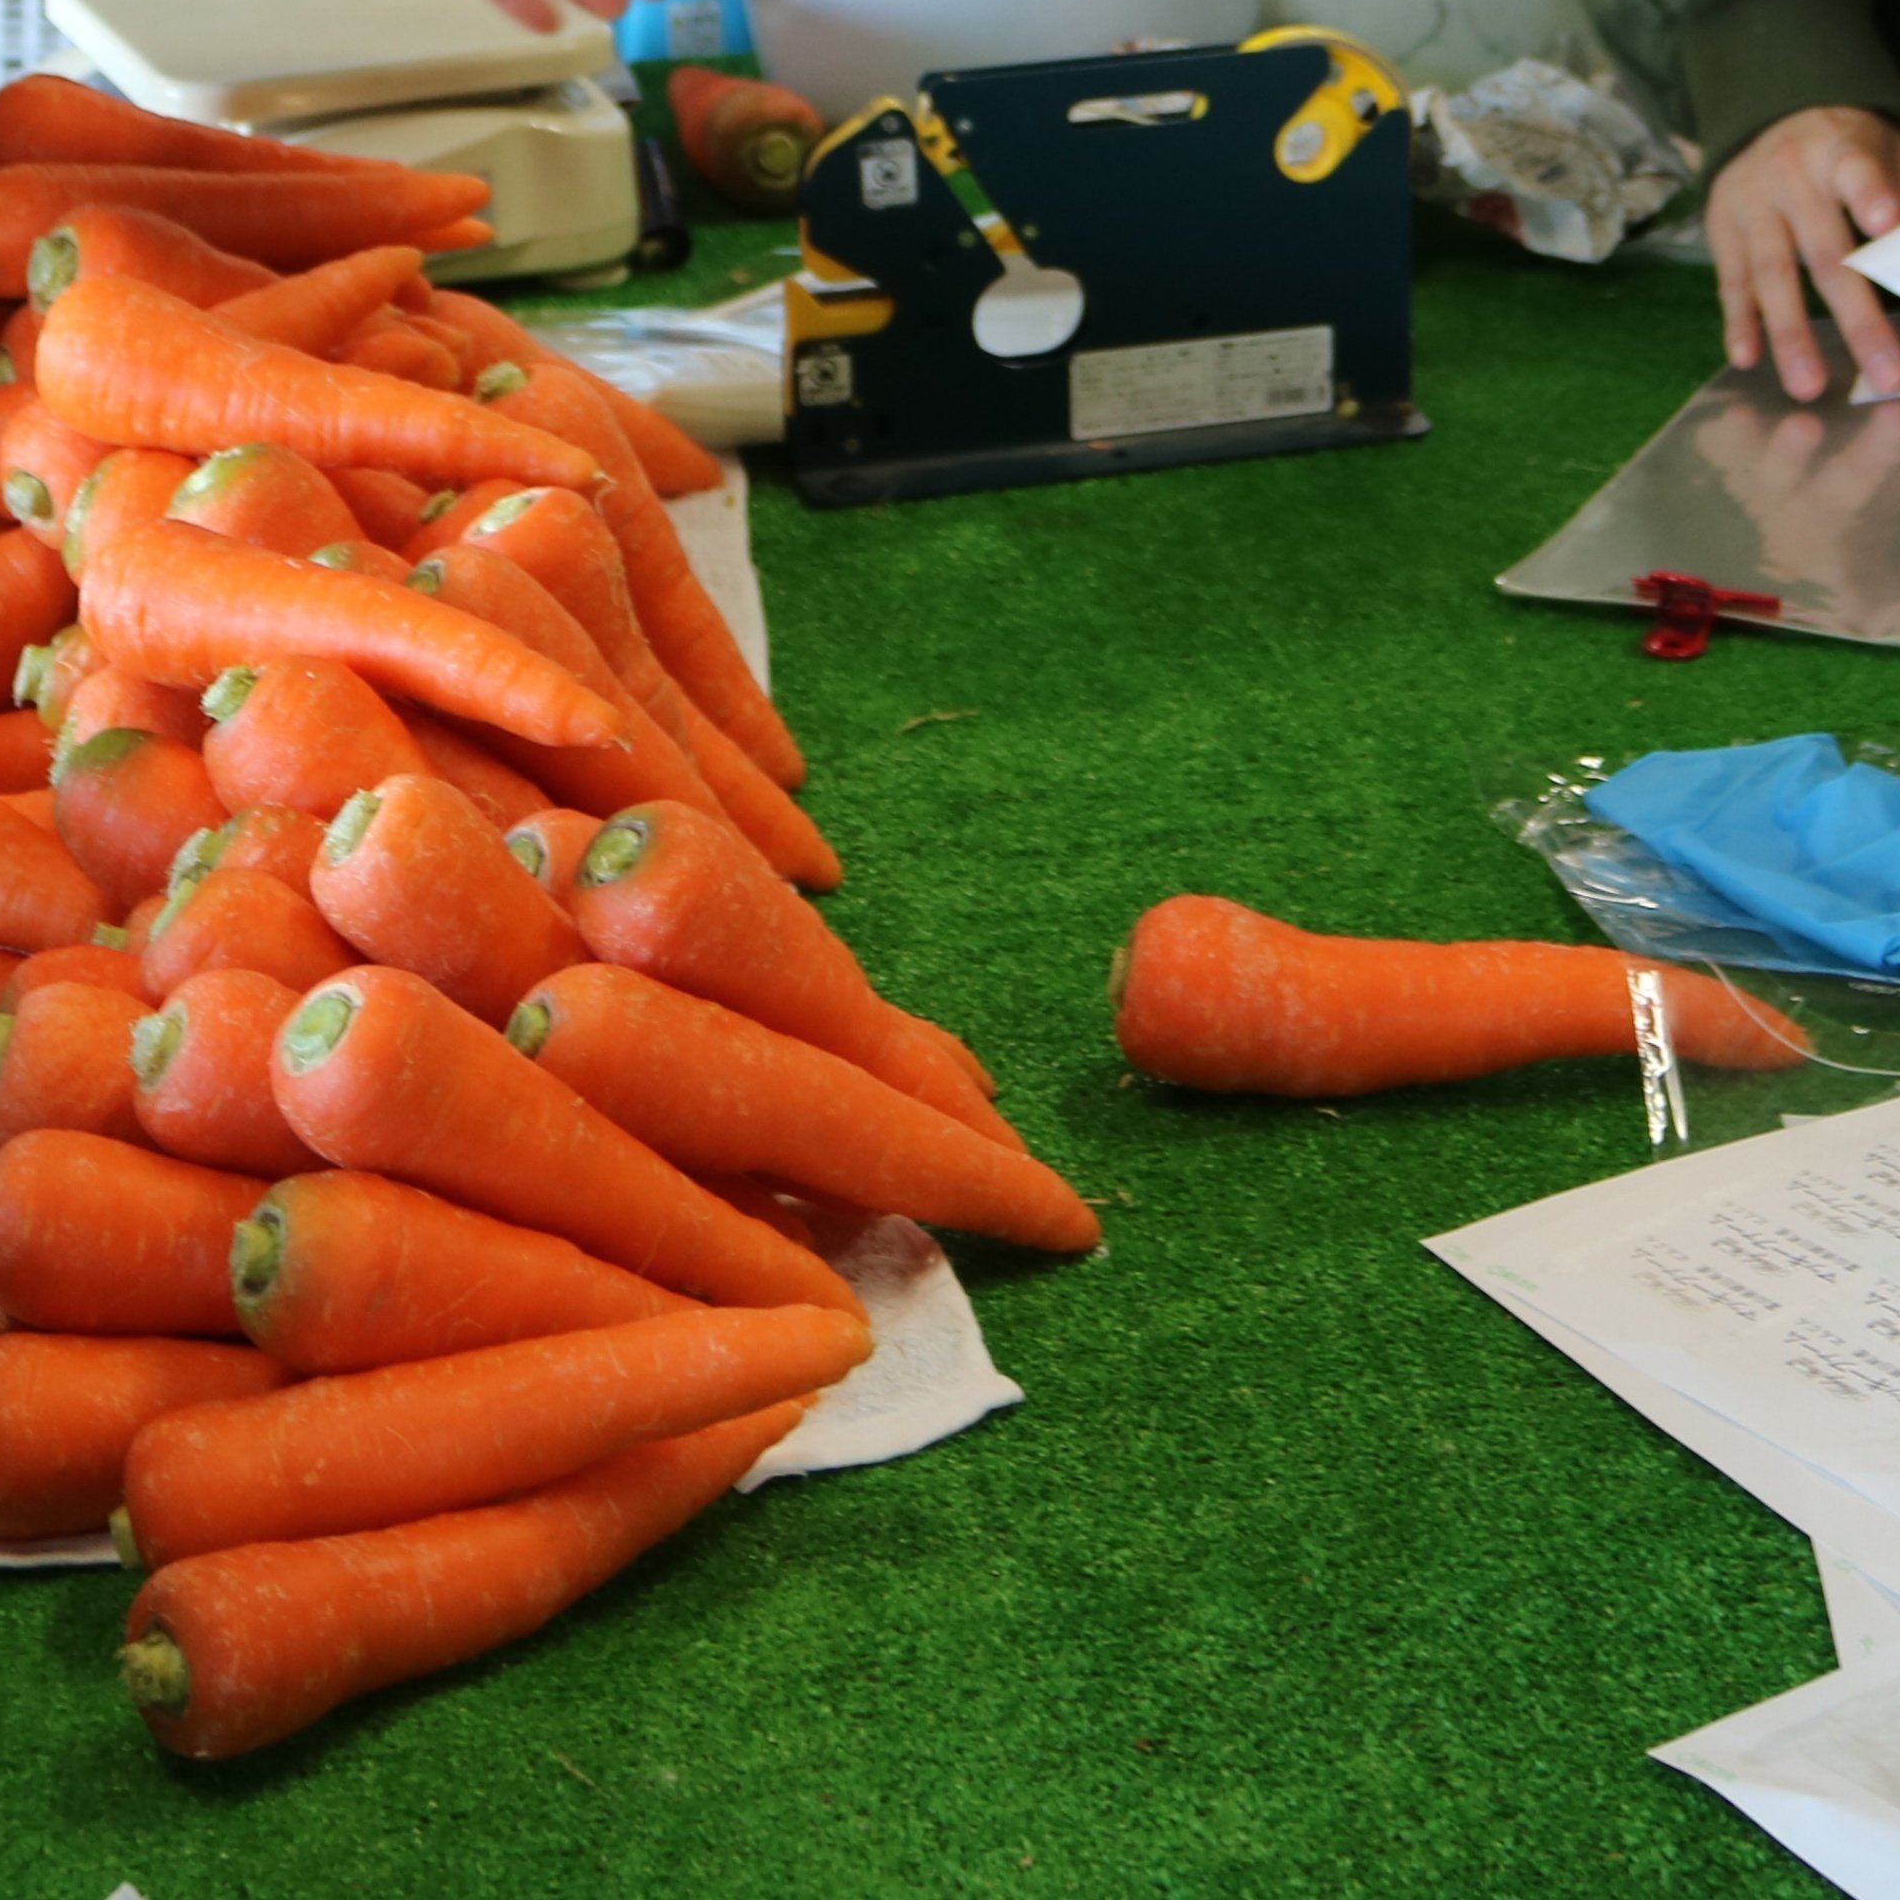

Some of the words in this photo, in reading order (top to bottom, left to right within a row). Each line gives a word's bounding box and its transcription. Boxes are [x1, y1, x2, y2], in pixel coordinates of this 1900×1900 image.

[1633, 1245, 1758, 1322] マッキーファーム
[1711, 1212, 1837, 1284] マッキーファーム
